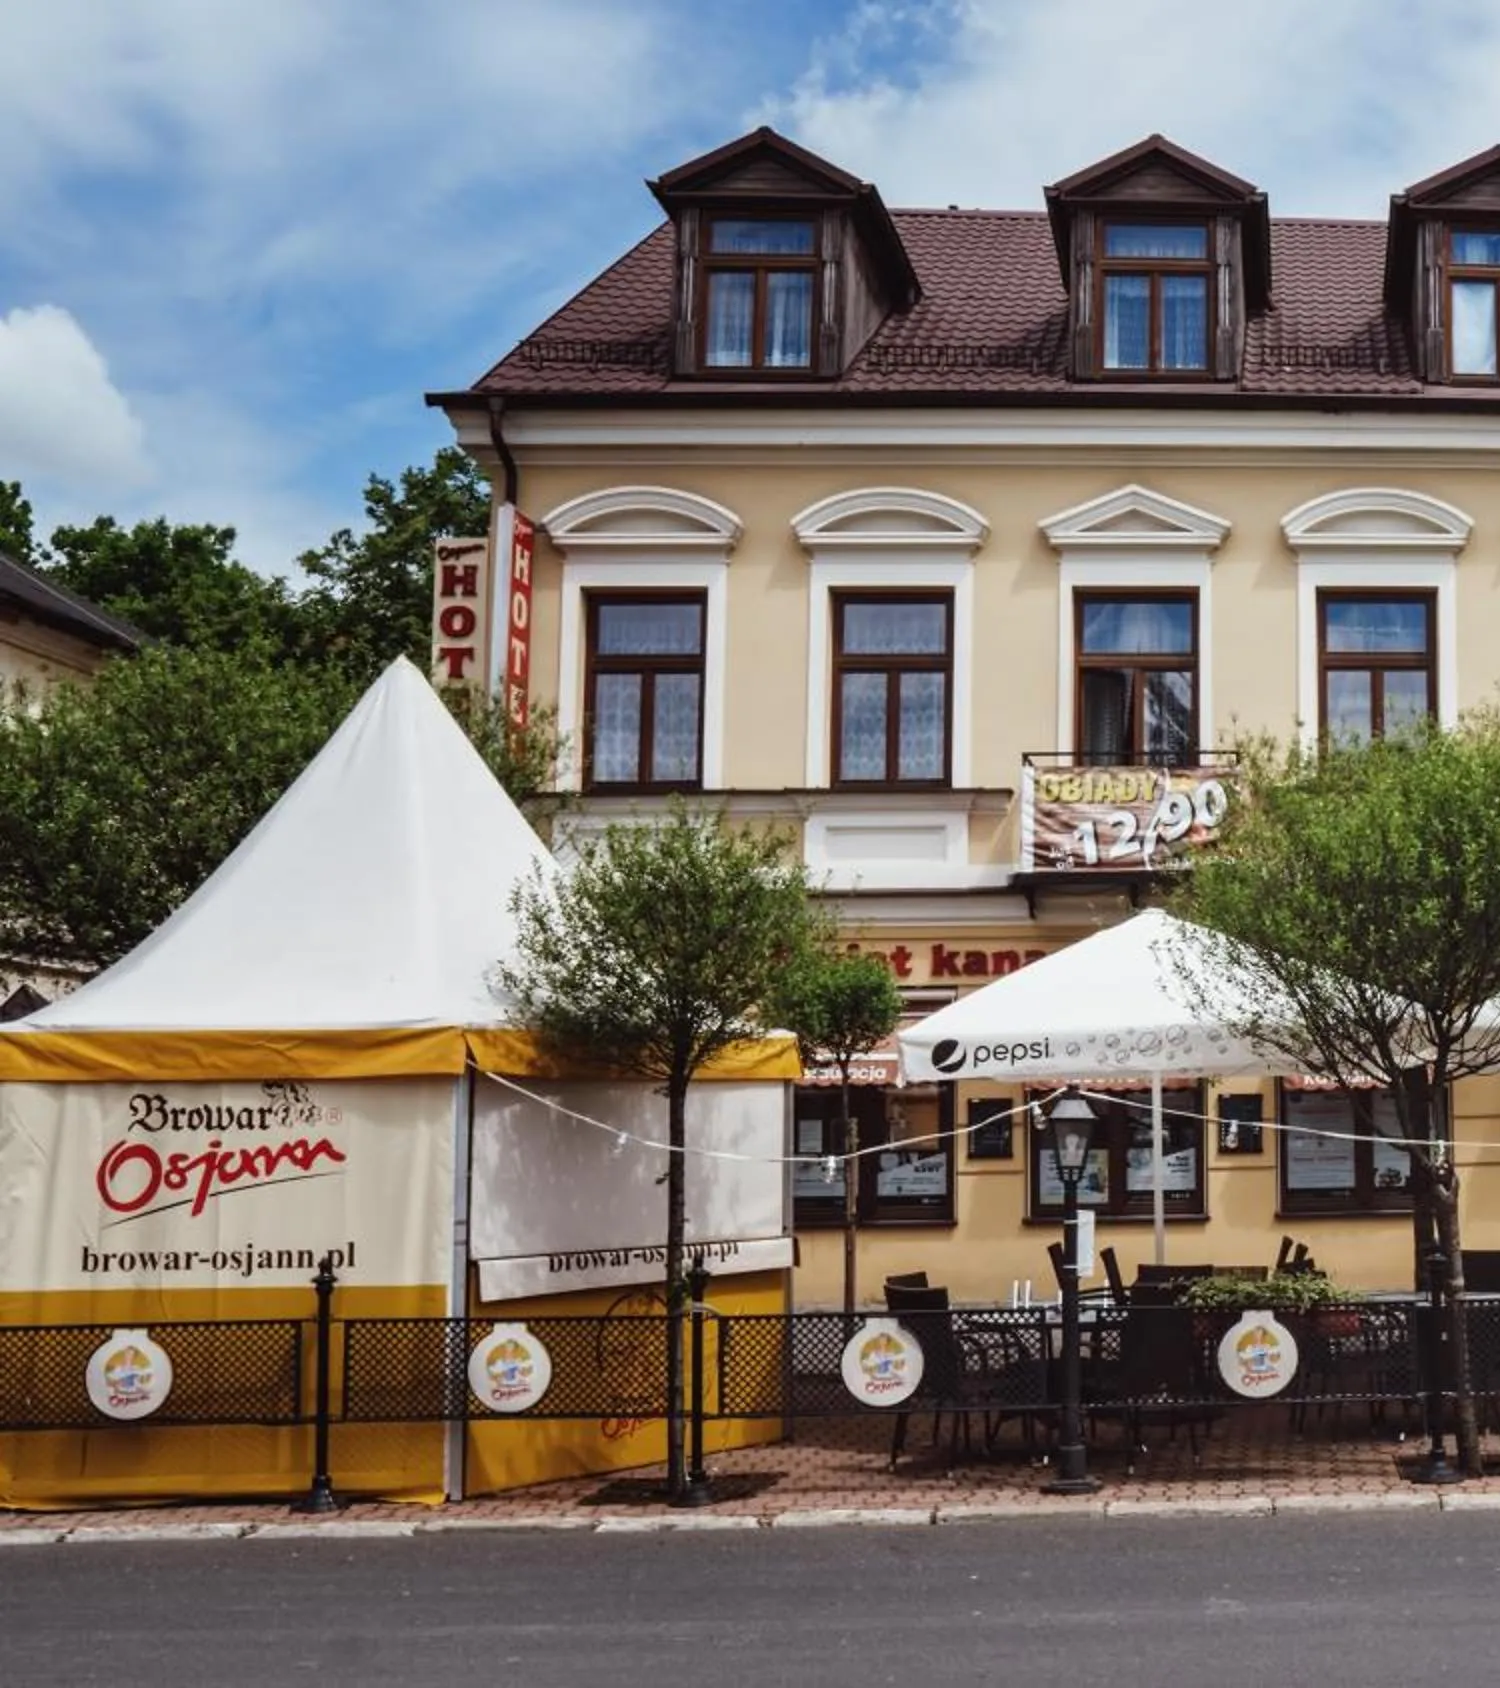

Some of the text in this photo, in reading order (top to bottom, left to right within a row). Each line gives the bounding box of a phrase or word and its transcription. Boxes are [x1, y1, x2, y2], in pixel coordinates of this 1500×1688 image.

[510, 543, 531, 757] HOTE
[973, 1037, 1050, 1068] pepsi
[128, 1093, 274, 1132] Browar
[97, 1139, 346, 1217] Osjann
[81, 1241, 356, 1277] browar-osjann.pl
